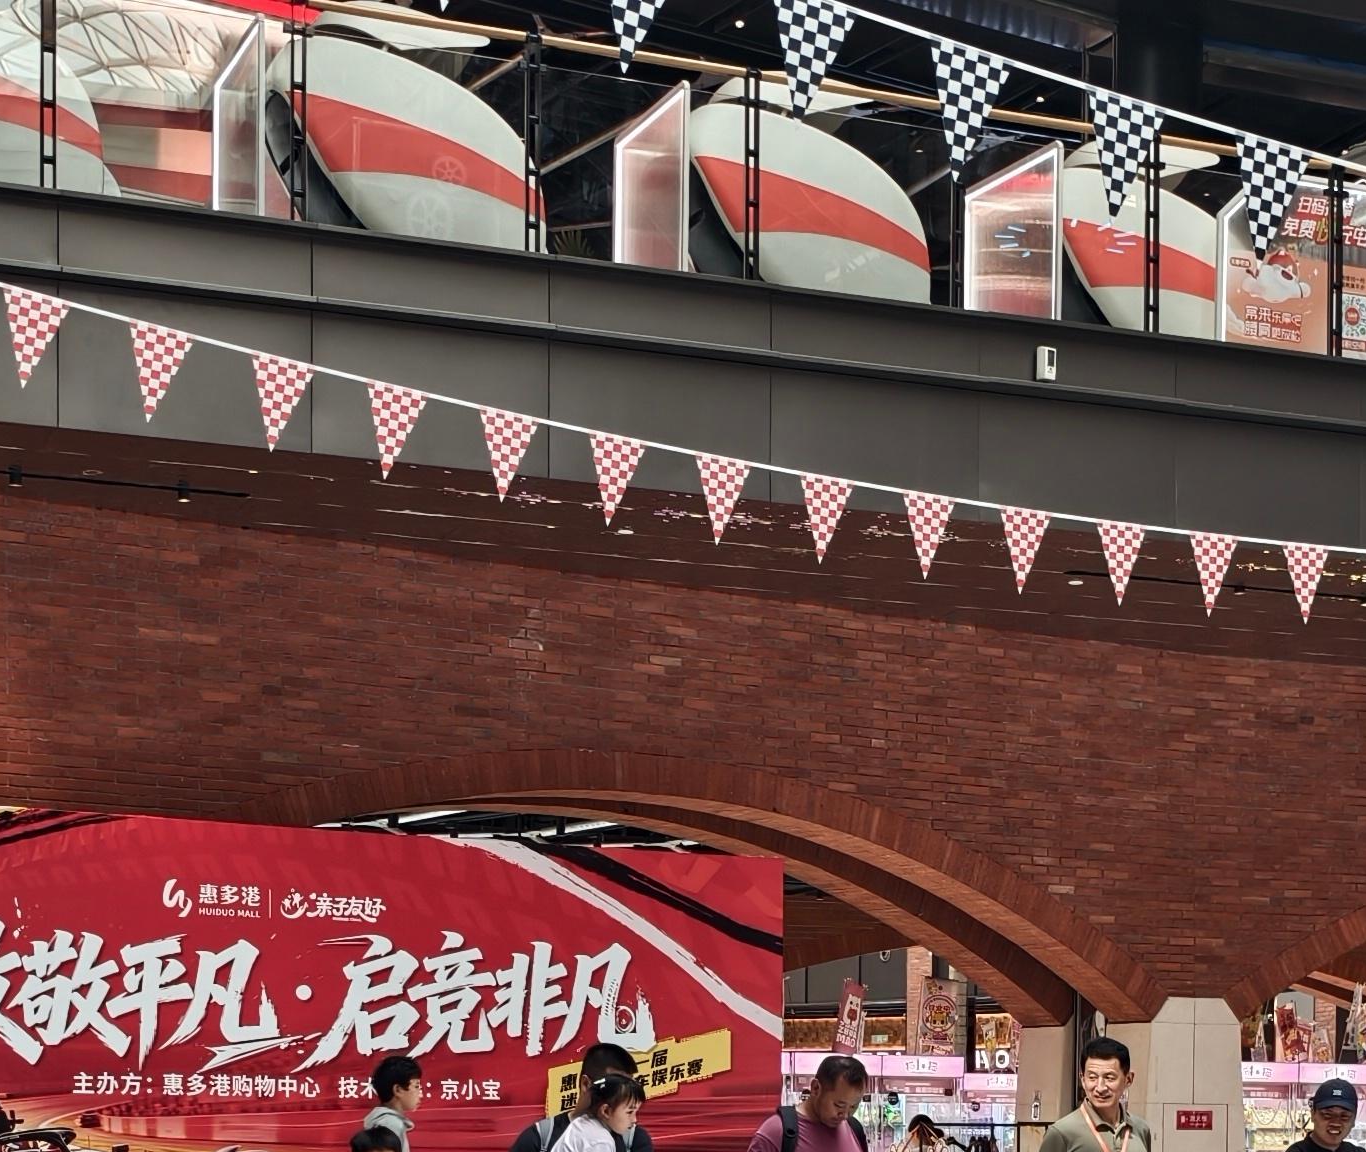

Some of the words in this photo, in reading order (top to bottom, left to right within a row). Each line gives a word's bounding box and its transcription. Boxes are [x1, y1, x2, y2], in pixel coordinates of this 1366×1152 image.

[198, 884, 261, 906] 惠多港
[198, 908, 235, 918] HUIDUO
[237, 909, 261, 919] MALL
[306, 893, 387, 923] 亲子友好
